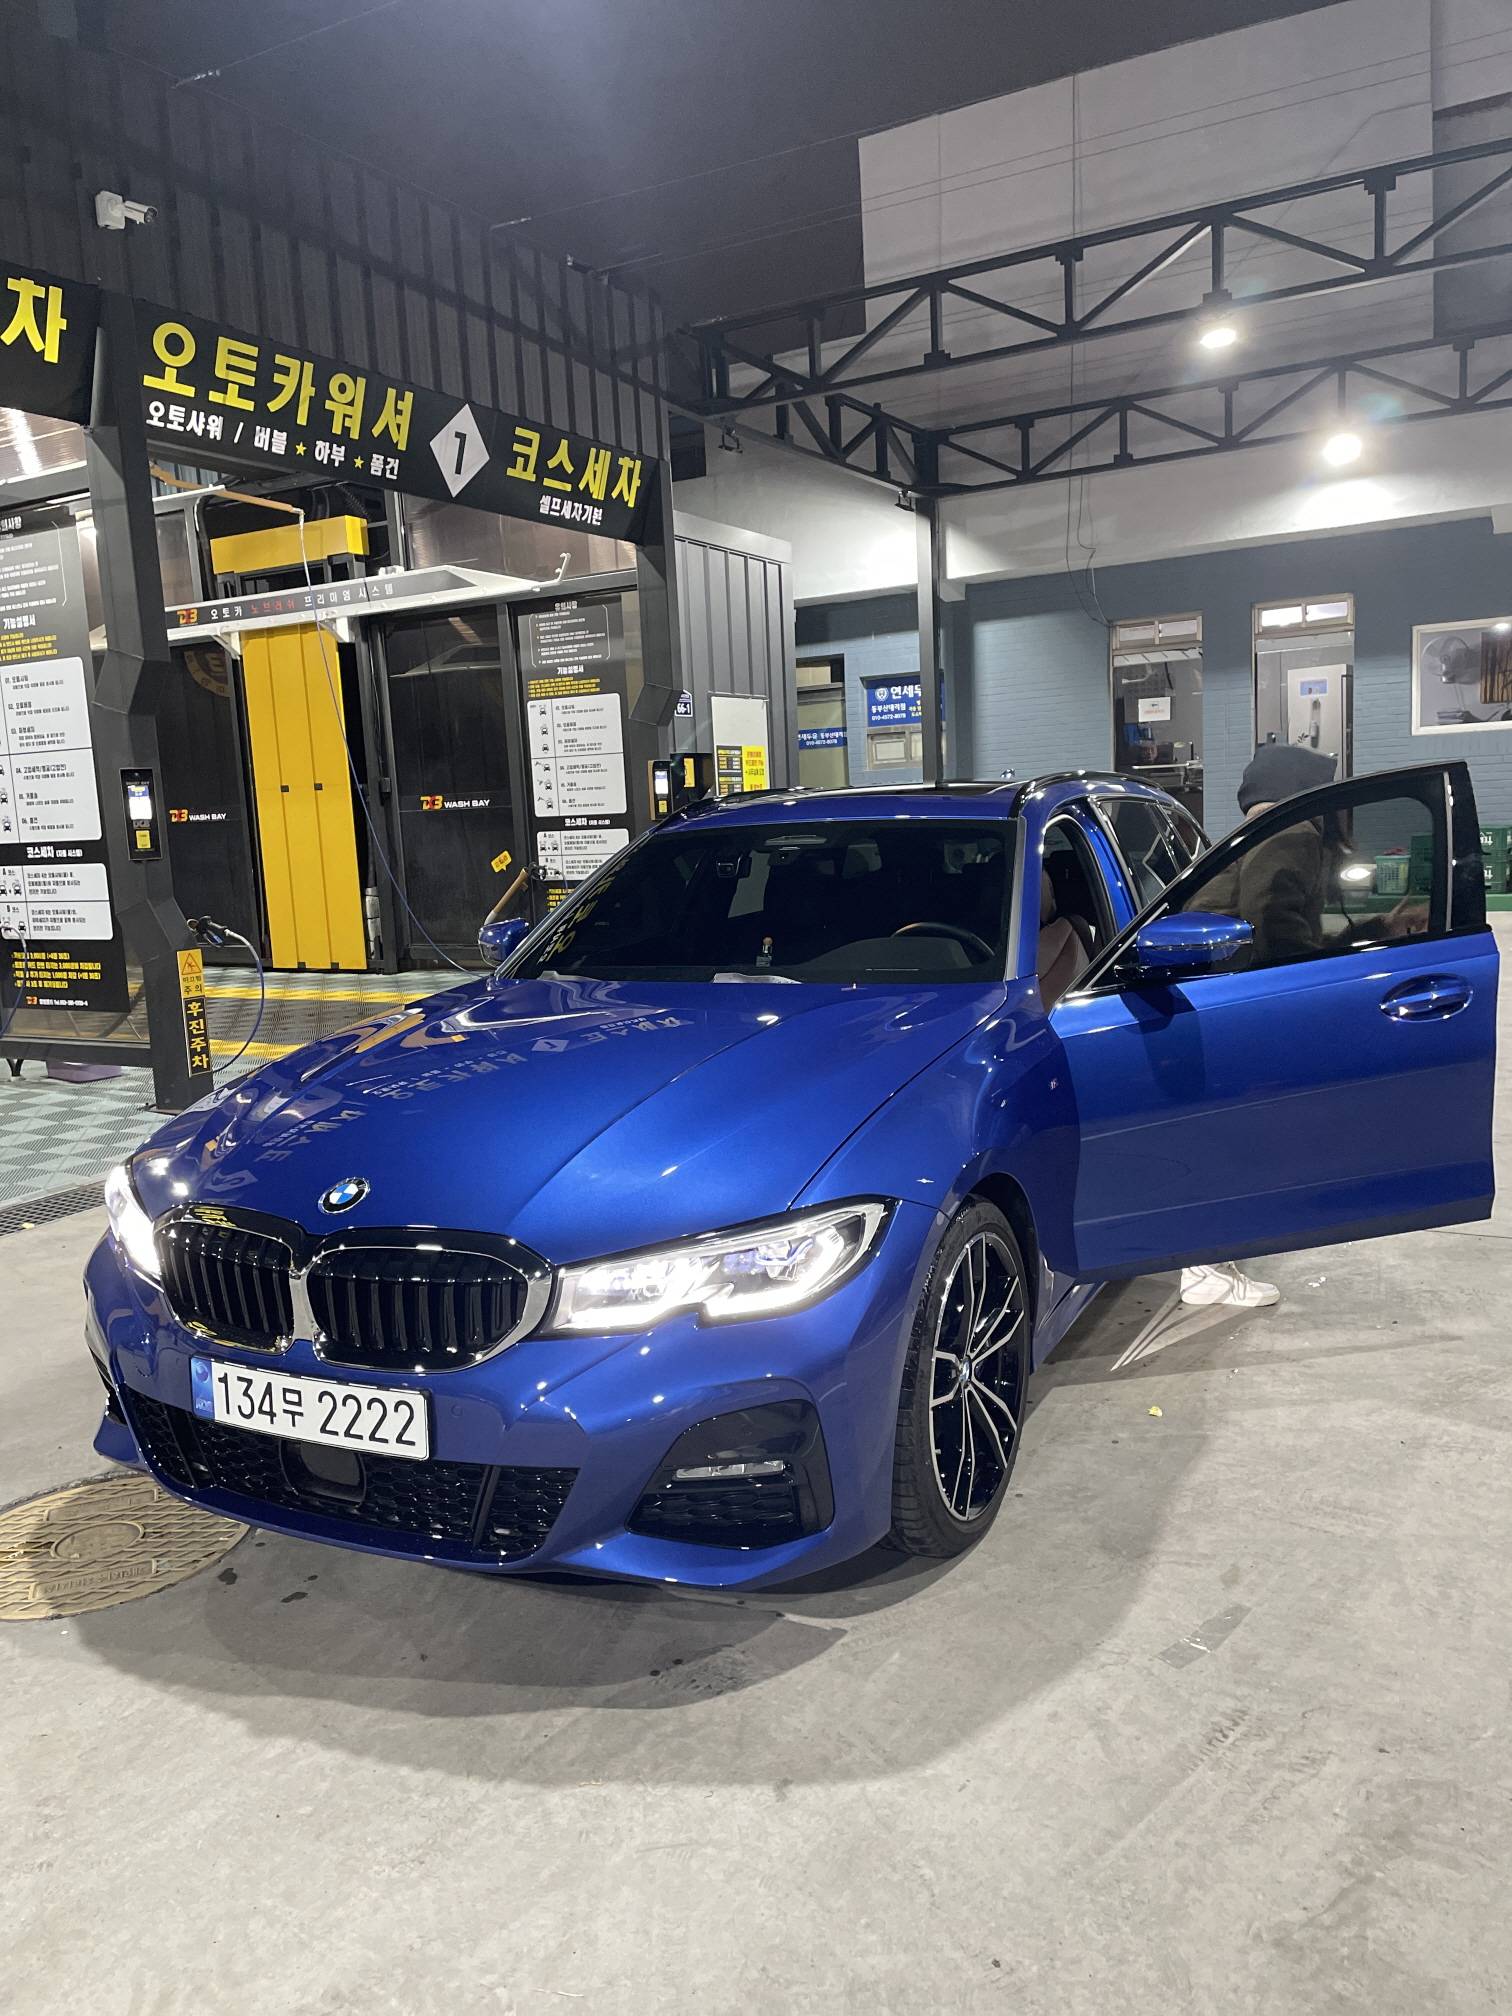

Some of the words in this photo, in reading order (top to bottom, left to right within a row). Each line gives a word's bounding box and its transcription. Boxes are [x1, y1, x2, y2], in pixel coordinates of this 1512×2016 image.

[143, 322, 414, 452] 오토카워셔
[146, 400, 225, 441] 오토샤워
[253, 425, 288, 455] 버블
[313, 440, 346, 468] 하부
[369, 453, 400, 480] 폼건
[453, 431, 467, 475] 1
[506, 426, 642, 509] 코스세차
[676, 703, 691, 714] 66-1
[444, 800, 471, 809] WASH
[472, 799, 491, 807] BAY
[186, 1001, 209, 1069] 후진주차
[217, 1372, 304, 1427] 134무
[317, 1390, 417, 1446] 2222
